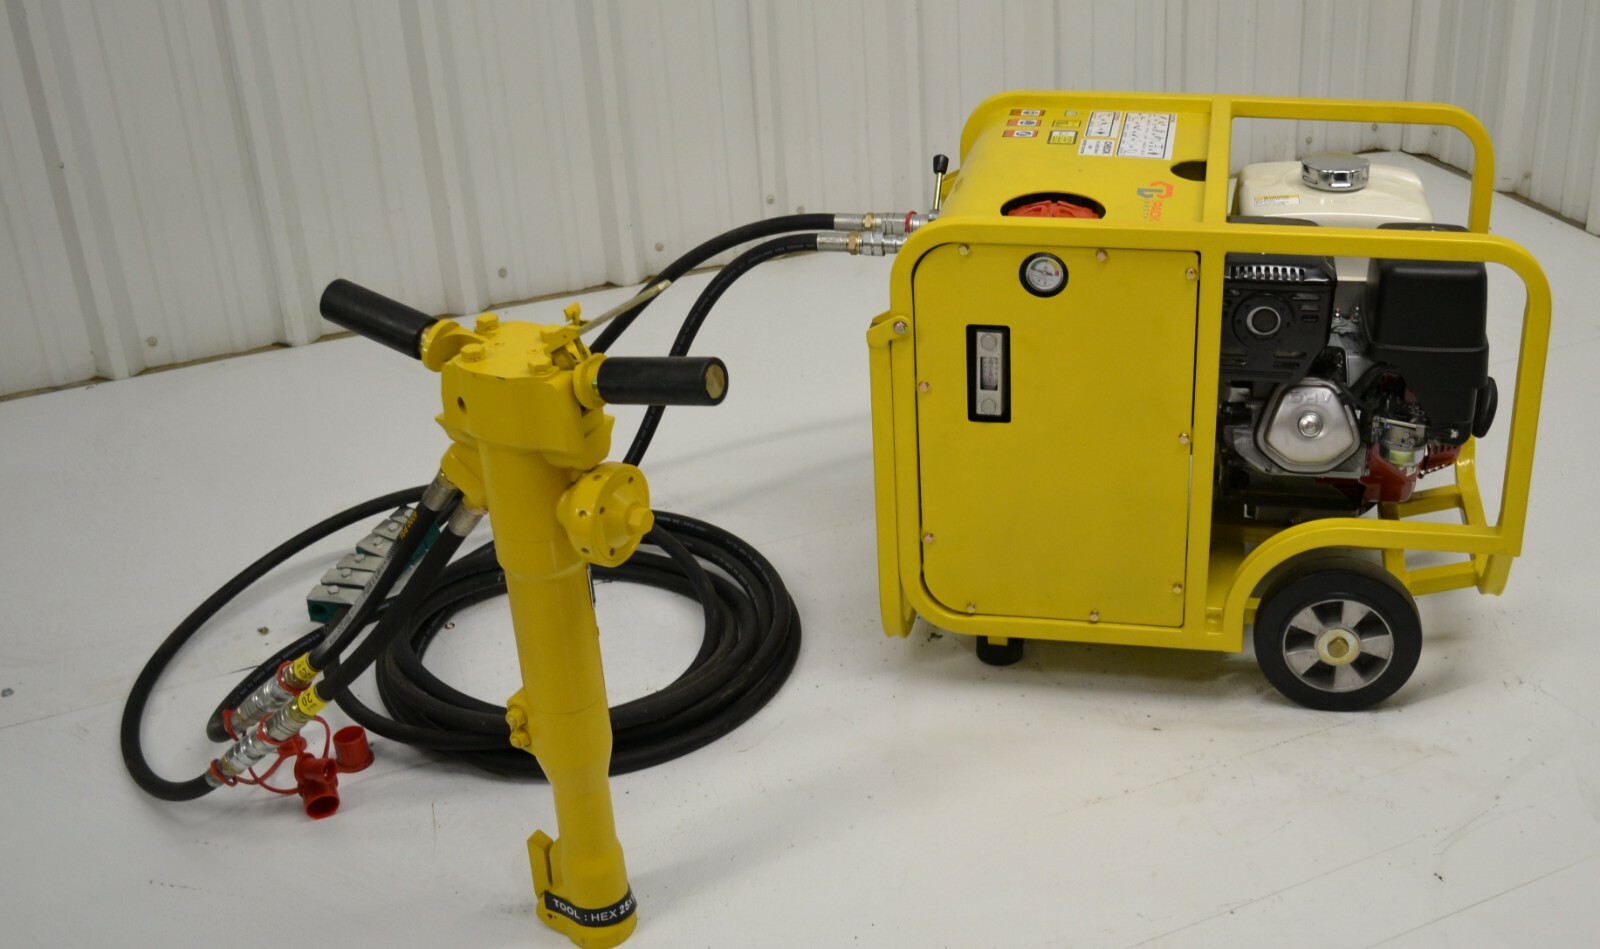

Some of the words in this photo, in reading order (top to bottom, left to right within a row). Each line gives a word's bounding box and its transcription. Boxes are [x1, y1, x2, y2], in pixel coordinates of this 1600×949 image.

[302, 692, 313, 707] 20
[553, 898, 580, 919] TOOL
[590, 909, 617, 921] HEX
